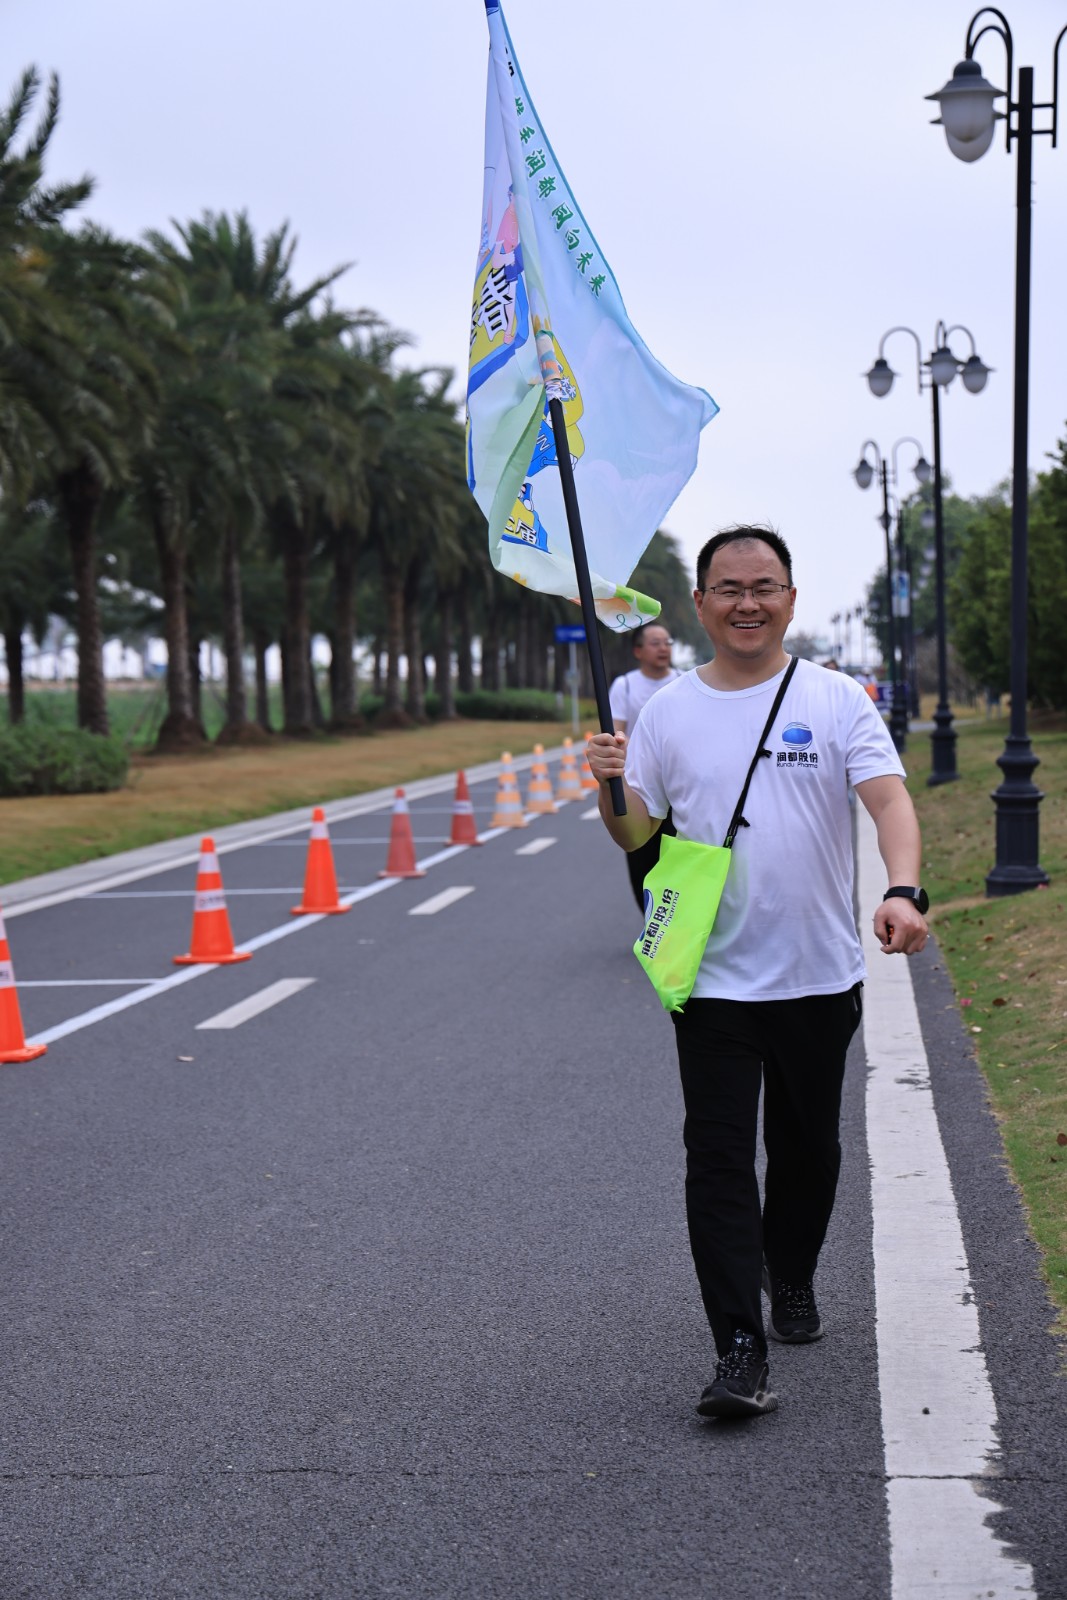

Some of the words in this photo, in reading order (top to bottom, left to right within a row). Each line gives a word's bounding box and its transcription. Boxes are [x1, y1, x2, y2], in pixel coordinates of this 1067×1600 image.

[777, 752, 818, 763] 润都股份
[642, 888, 674, 957] 润都股份
[649, 930, 665, 959] Rundu
[663, 891, 680, 928] Pharma
